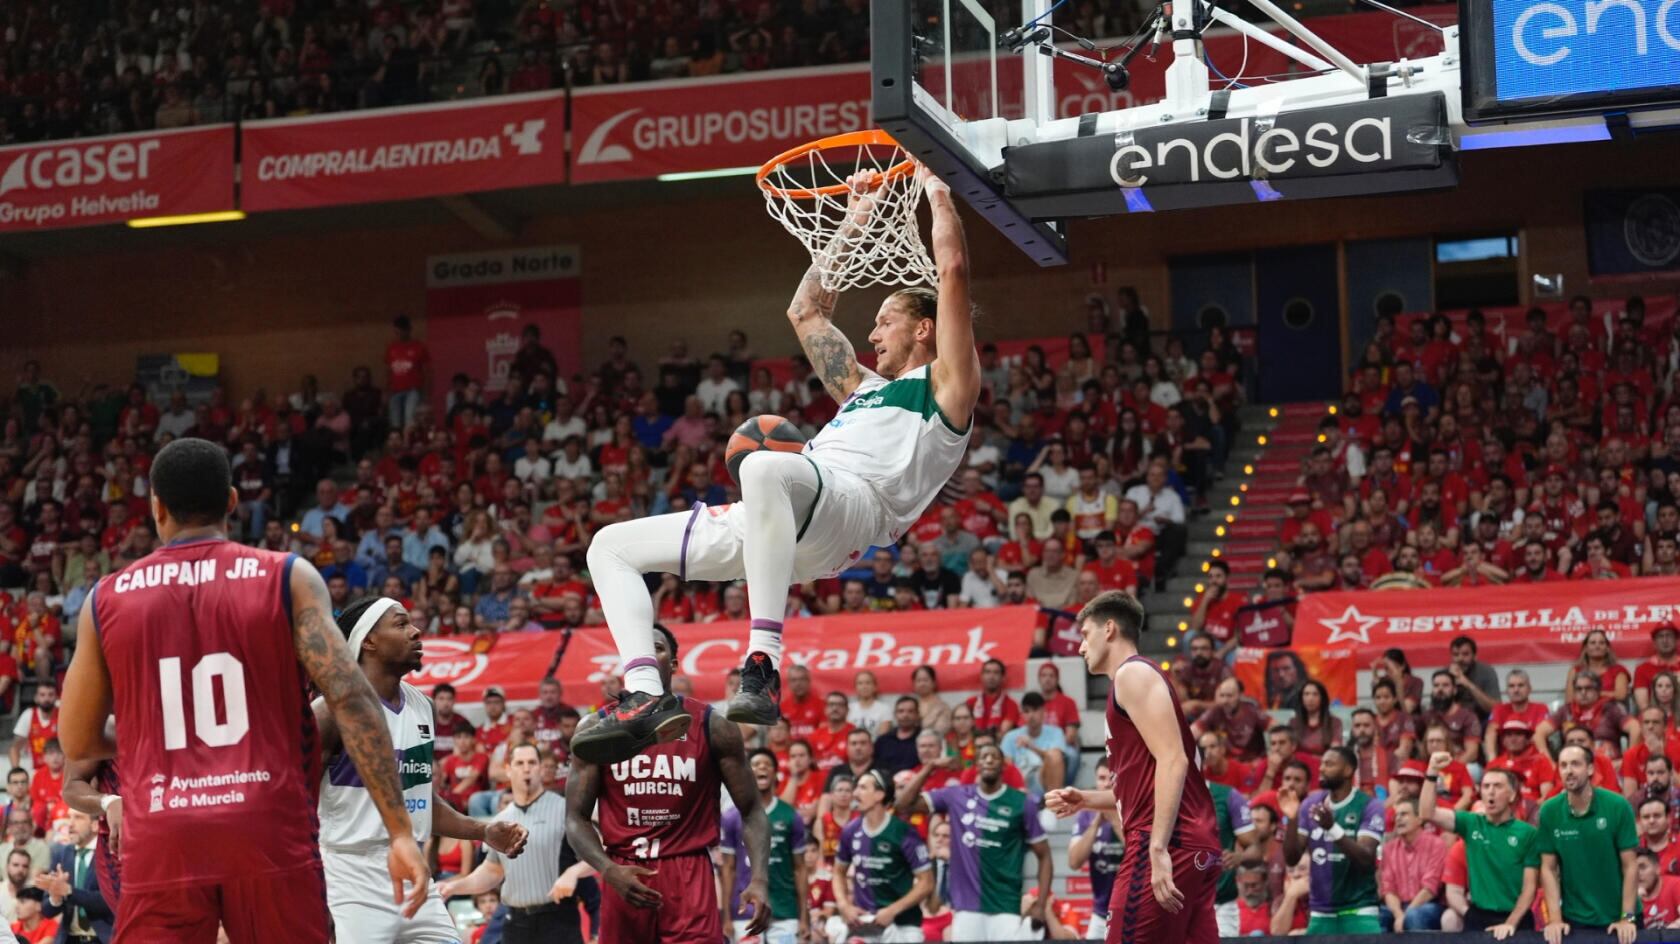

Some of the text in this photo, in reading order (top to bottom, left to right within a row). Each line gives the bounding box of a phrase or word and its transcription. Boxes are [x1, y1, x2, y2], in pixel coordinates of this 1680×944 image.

[1512, 0, 1680, 65] en
[30, 140, 161, 188] caser
[258, 136, 502, 181] COMPRALAENTRADA
[1109, 116, 1392, 188] endesa
[0, 189, 160, 225] Grupo Helvetia
[433, 254, 573, 280] Grada Norte
[114, 557, 267, 594] CAUPAIN JR.
[1386, 606, 1588, 634] ESTRELLA
[1594, 609, 1620, 621] DE
[681, 625, 998, 677] CxaBank
[158, 651, 250, 751] 10
[169, 769, 271, 791] Ayuntamiento
[610, 753, 696, 783] UCAM
[168, 791, 245, 809] de Murcia
[623, 781, 684, 797] MURCIA
